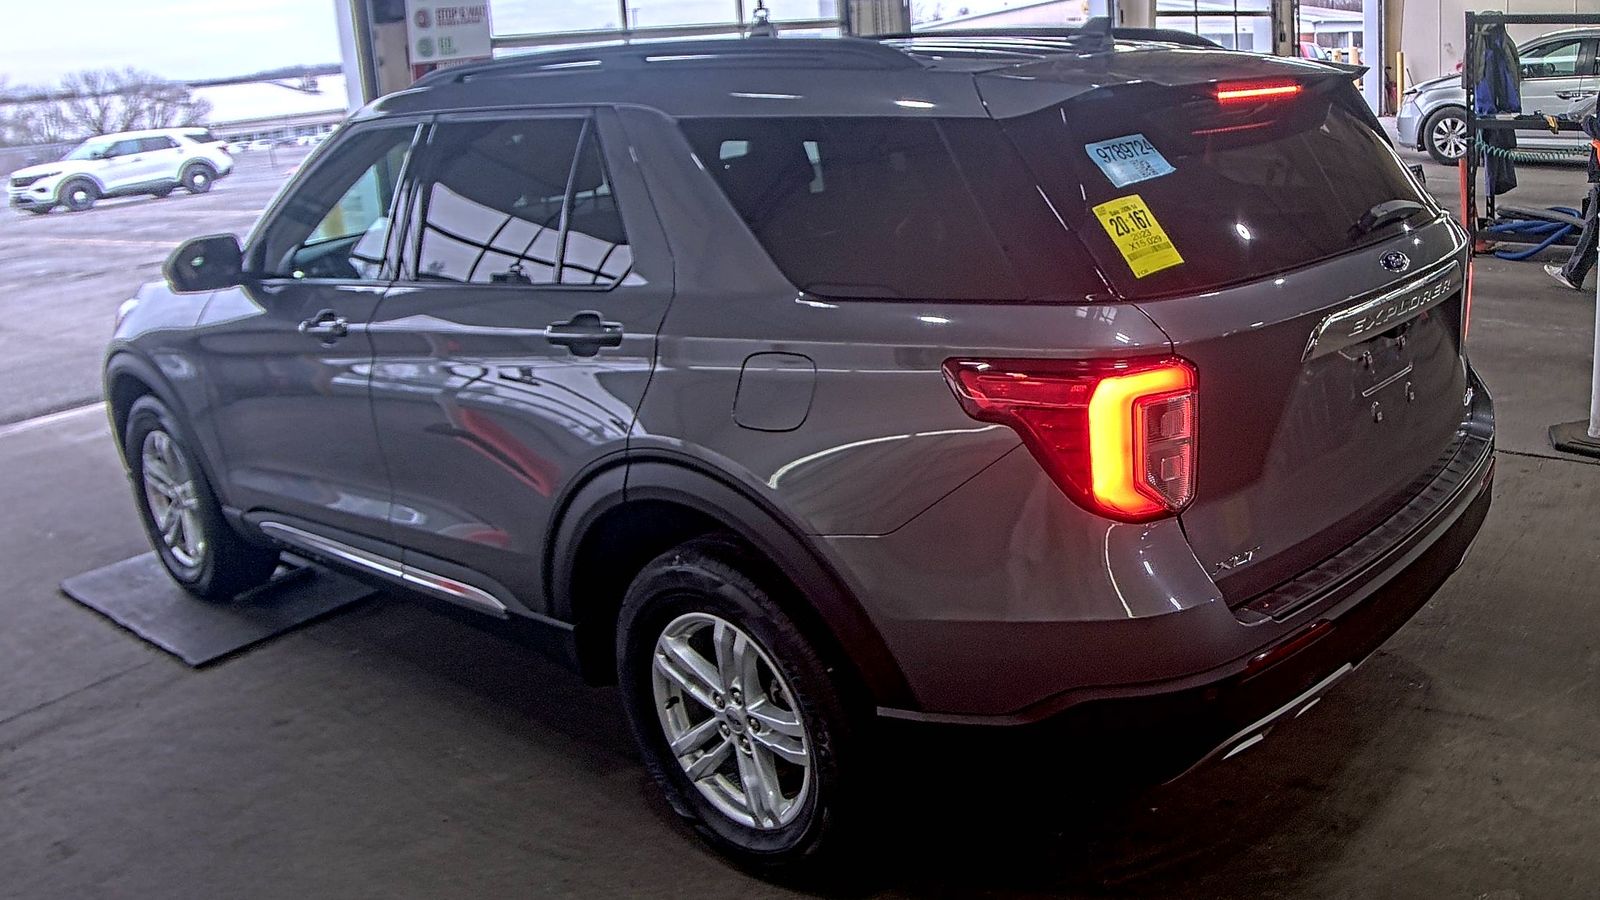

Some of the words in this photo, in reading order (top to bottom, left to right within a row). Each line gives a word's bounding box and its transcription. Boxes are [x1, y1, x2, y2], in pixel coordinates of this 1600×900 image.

[1096, 139, 1156, 164] 9789724
[1348, 279, 1452, 337] EXPLORER
[1212, 546, 1261, 576] XLT
